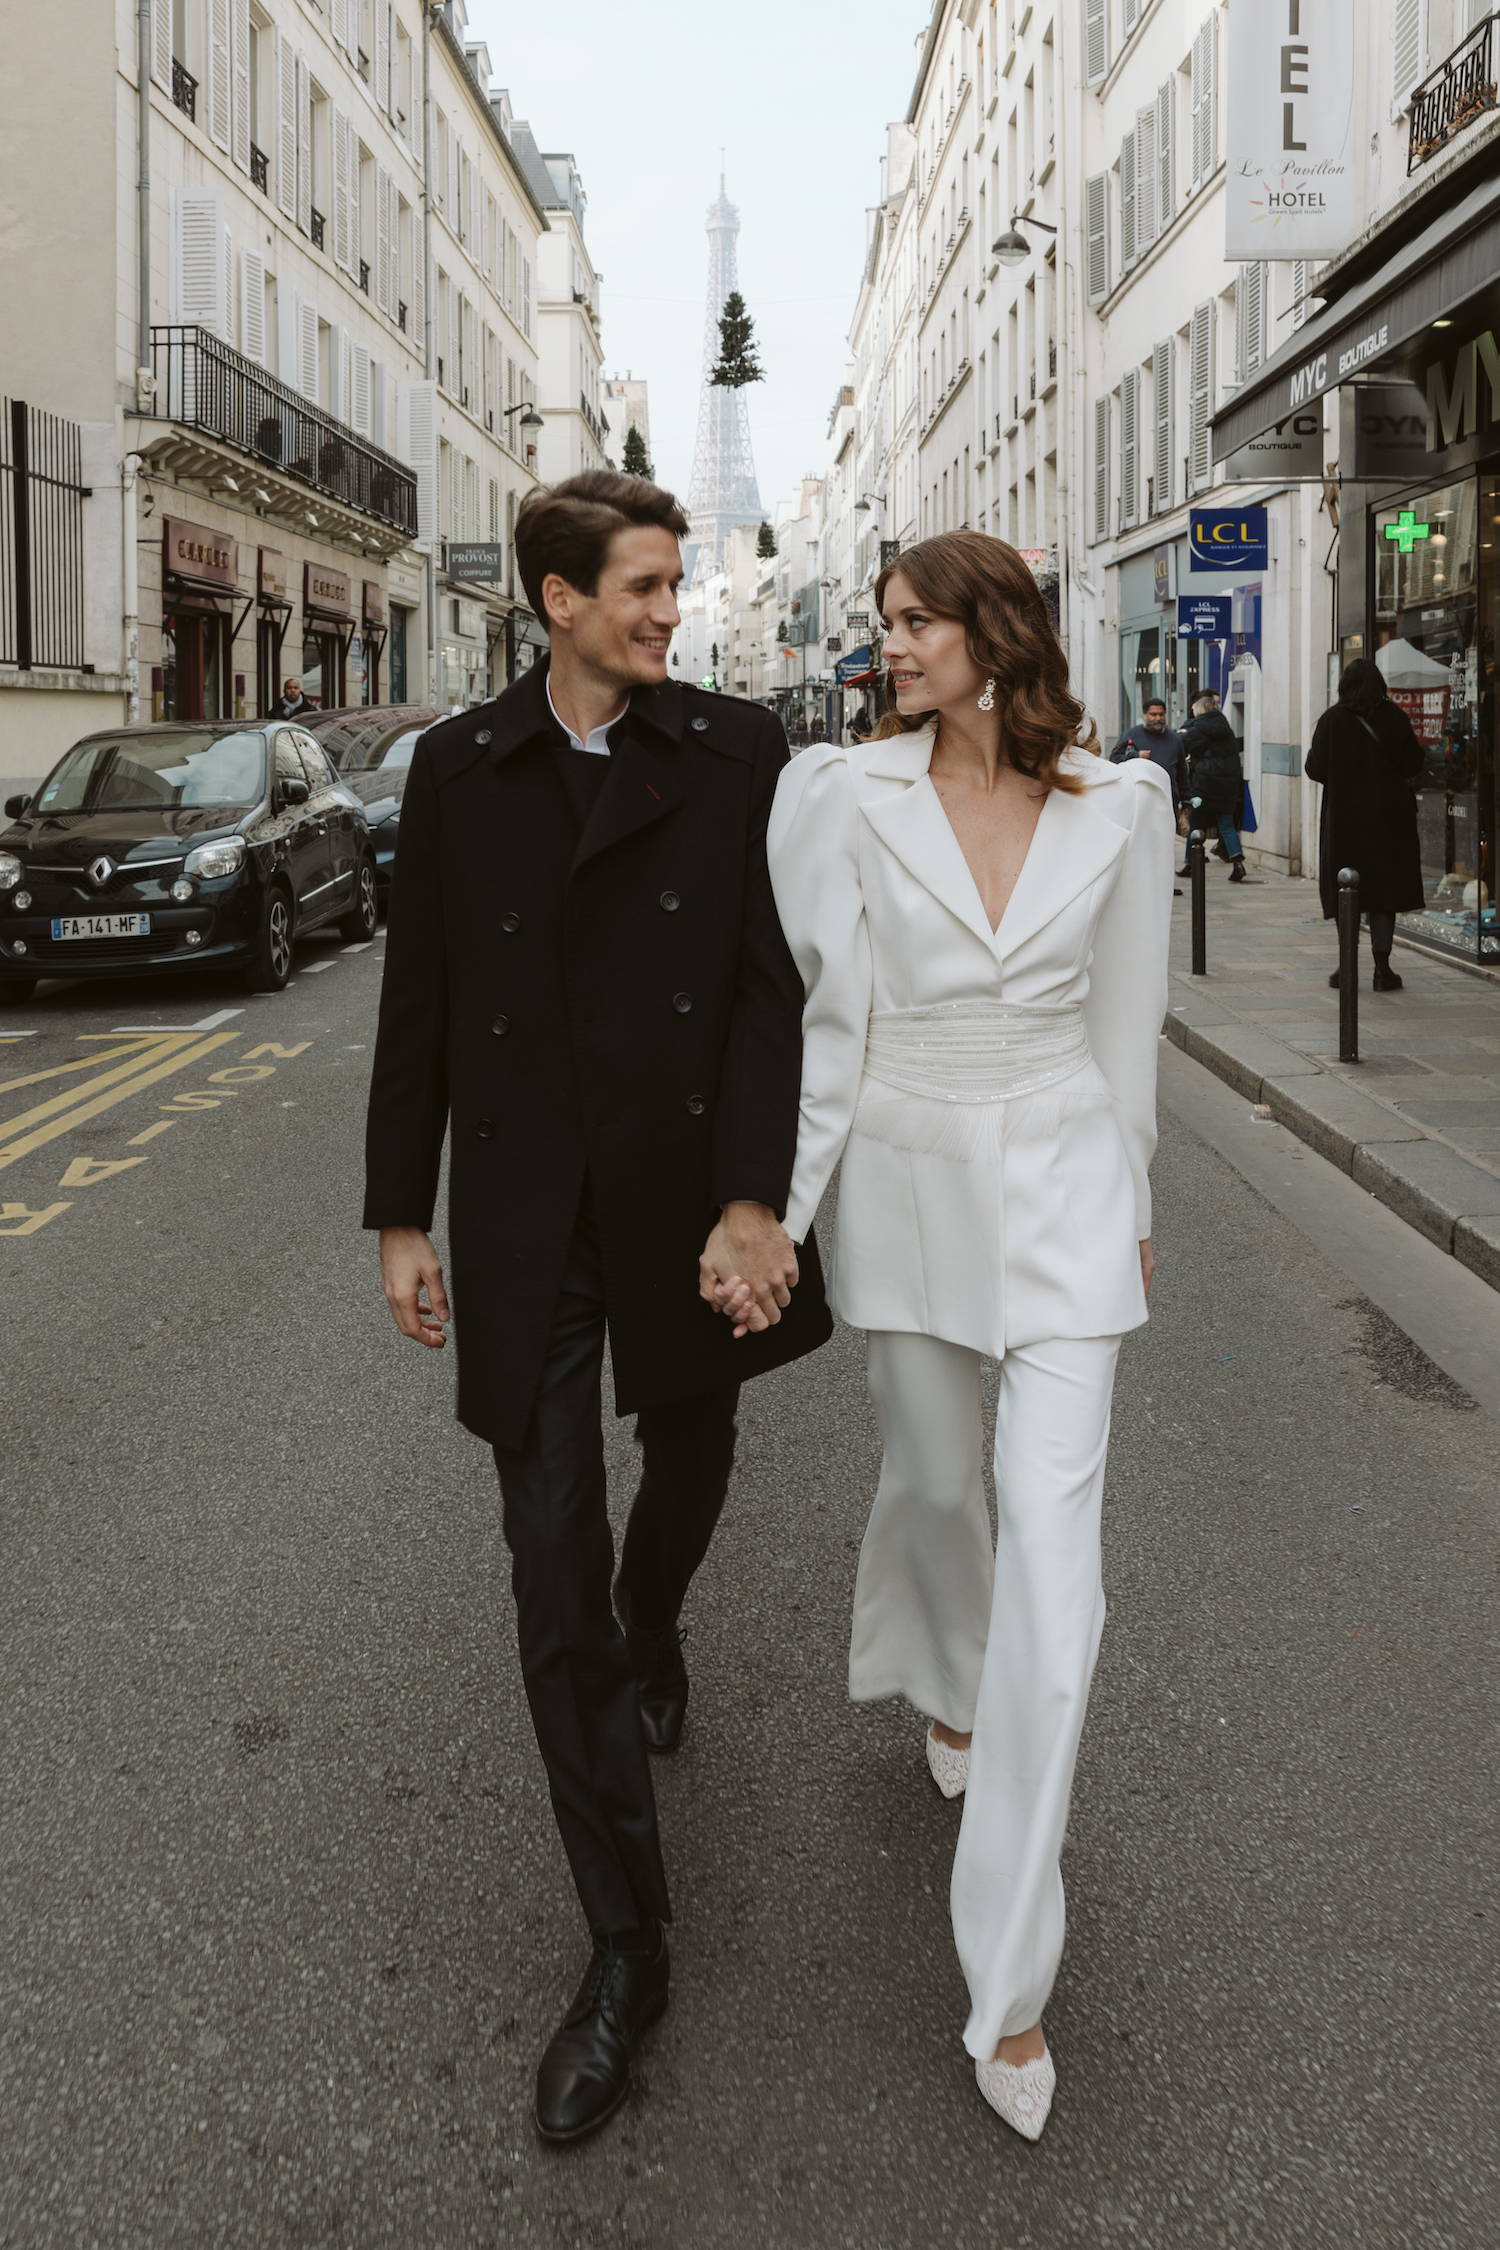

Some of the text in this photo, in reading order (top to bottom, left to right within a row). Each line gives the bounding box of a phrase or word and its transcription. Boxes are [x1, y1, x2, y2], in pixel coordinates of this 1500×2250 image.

[1234, 156, 1346, 177] Le Pavillon
[1268, 192, 1326, 207] HOTEL
[1290, 325, 1388, 407] MYC BOUTIQUE
[1261, 415, 1317, 436] YC
[1249, 442, 1303, 451] BOUTIQUE
[1196, 522, 1259, 543] LCL
[451, 552, 499, 563] PROVOST
[458, 569, 492, 577] COIFFURE
[1155, 559, 1168, 578] LCL
[1236, 633, 1247, 646] LCL
[1230, 654, 1253, 667] EXPRESS
[62, 915, 137, 936] FA-141-MF
